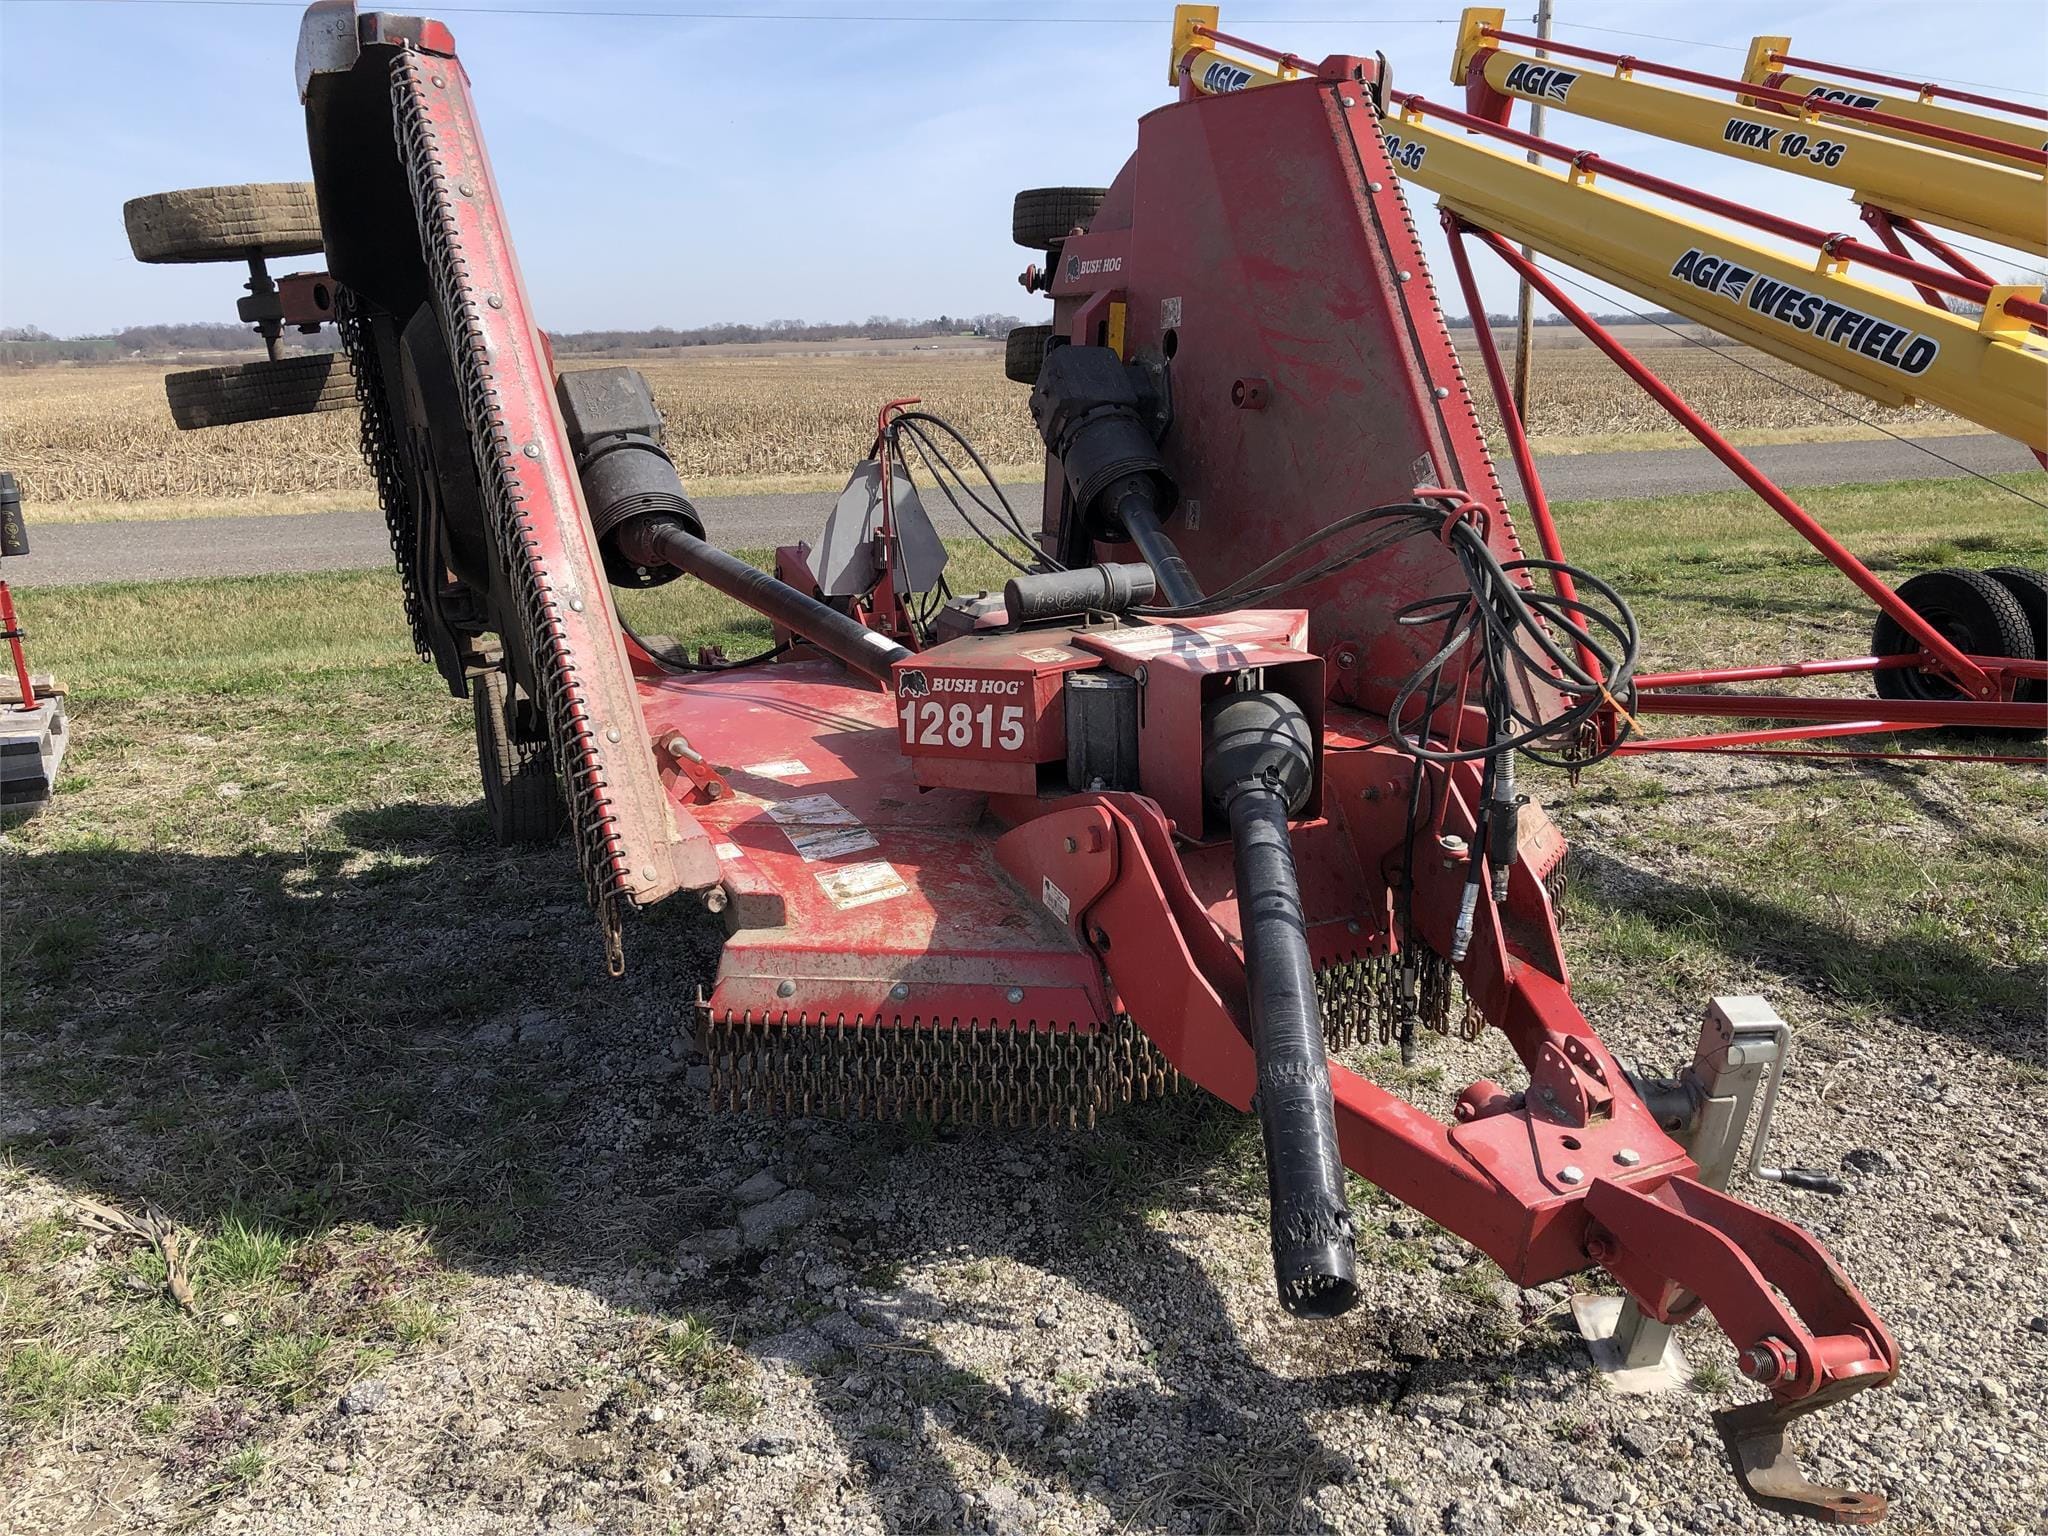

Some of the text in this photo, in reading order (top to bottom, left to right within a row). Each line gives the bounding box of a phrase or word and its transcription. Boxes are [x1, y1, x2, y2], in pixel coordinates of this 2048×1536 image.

[1203, 61, 1238, 94] AGI
[1504, 61, 1557, 98] AGI
[1723, 118, 1847, 169] WRX 10-36
[1080, 257, 1122, 274] BUSH HOG
[1671, 249, 1940, 378] AGI WESTFIELD
[931, 677, 977, 694] BUSH
[900, 700, 1025, 751] 12815
